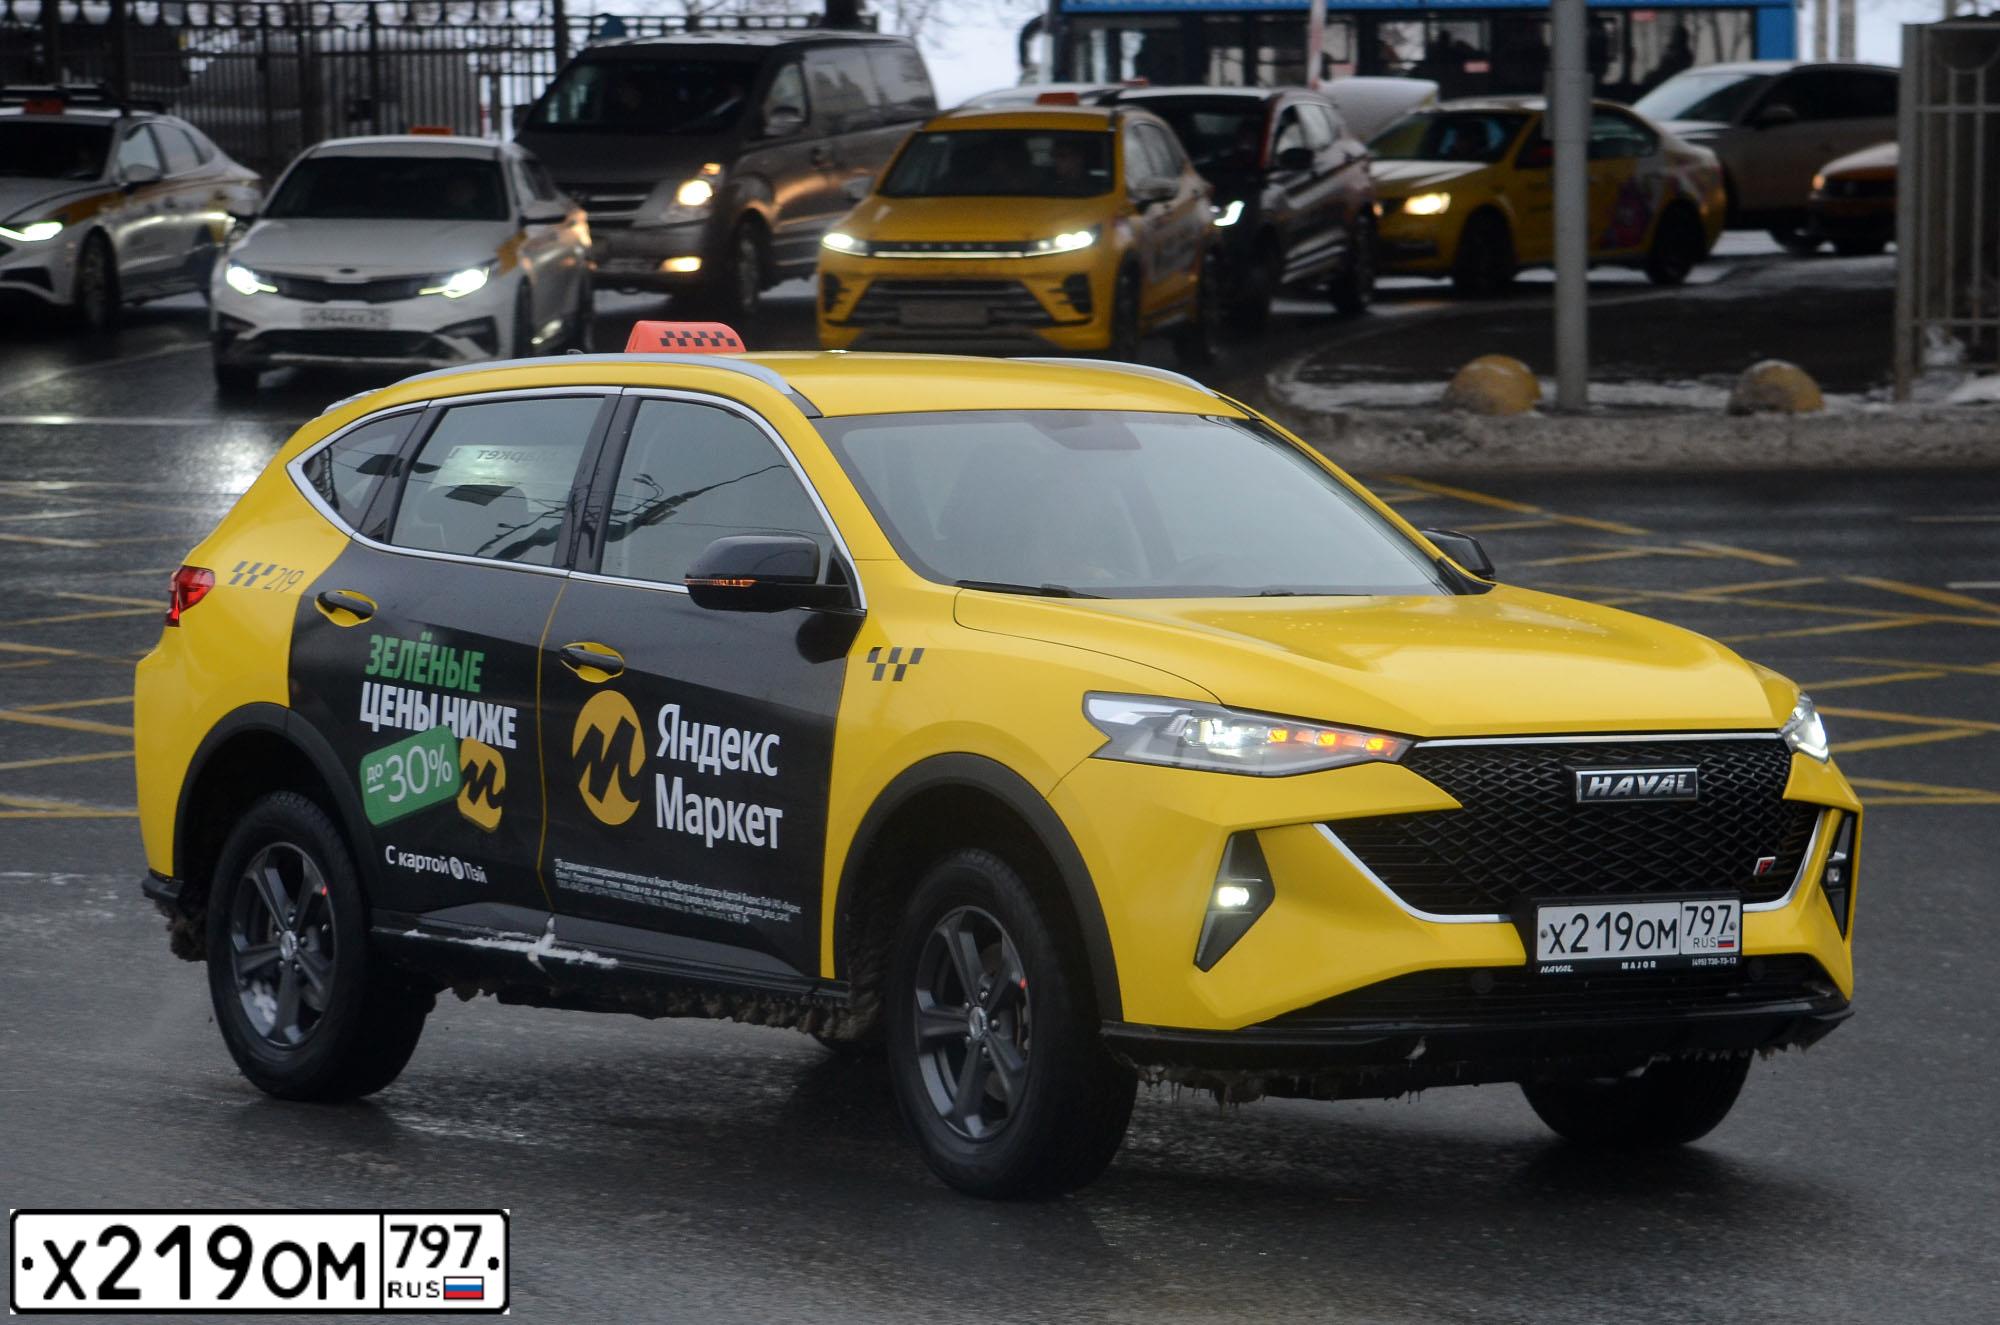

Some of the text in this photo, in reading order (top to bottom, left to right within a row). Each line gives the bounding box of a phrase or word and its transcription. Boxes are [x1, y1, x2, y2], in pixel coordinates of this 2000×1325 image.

[262, 567, 305, 593] 219
[364, 631, 486, 693] ЗЕЛЁНЫЕ
[359, 681, 518, 749] ЦЕНЫ НИЖЕ
[655, 703, 781, 777] Яндекс
[366, 763, 384, 785] до
[1586, 774, 1694, 797] HAVAL
[655, 773, 784, 849] Маркет
[385, 845, 396, 865] С
[398, 855, 450, 873] картой
[1684, 904, 1732, 936] 797
[1693, 936, 1717, 949] RUS
[1540, 965, 1574, 974] HAVAL
[1621, 961, 1657, 970] MAJOR
